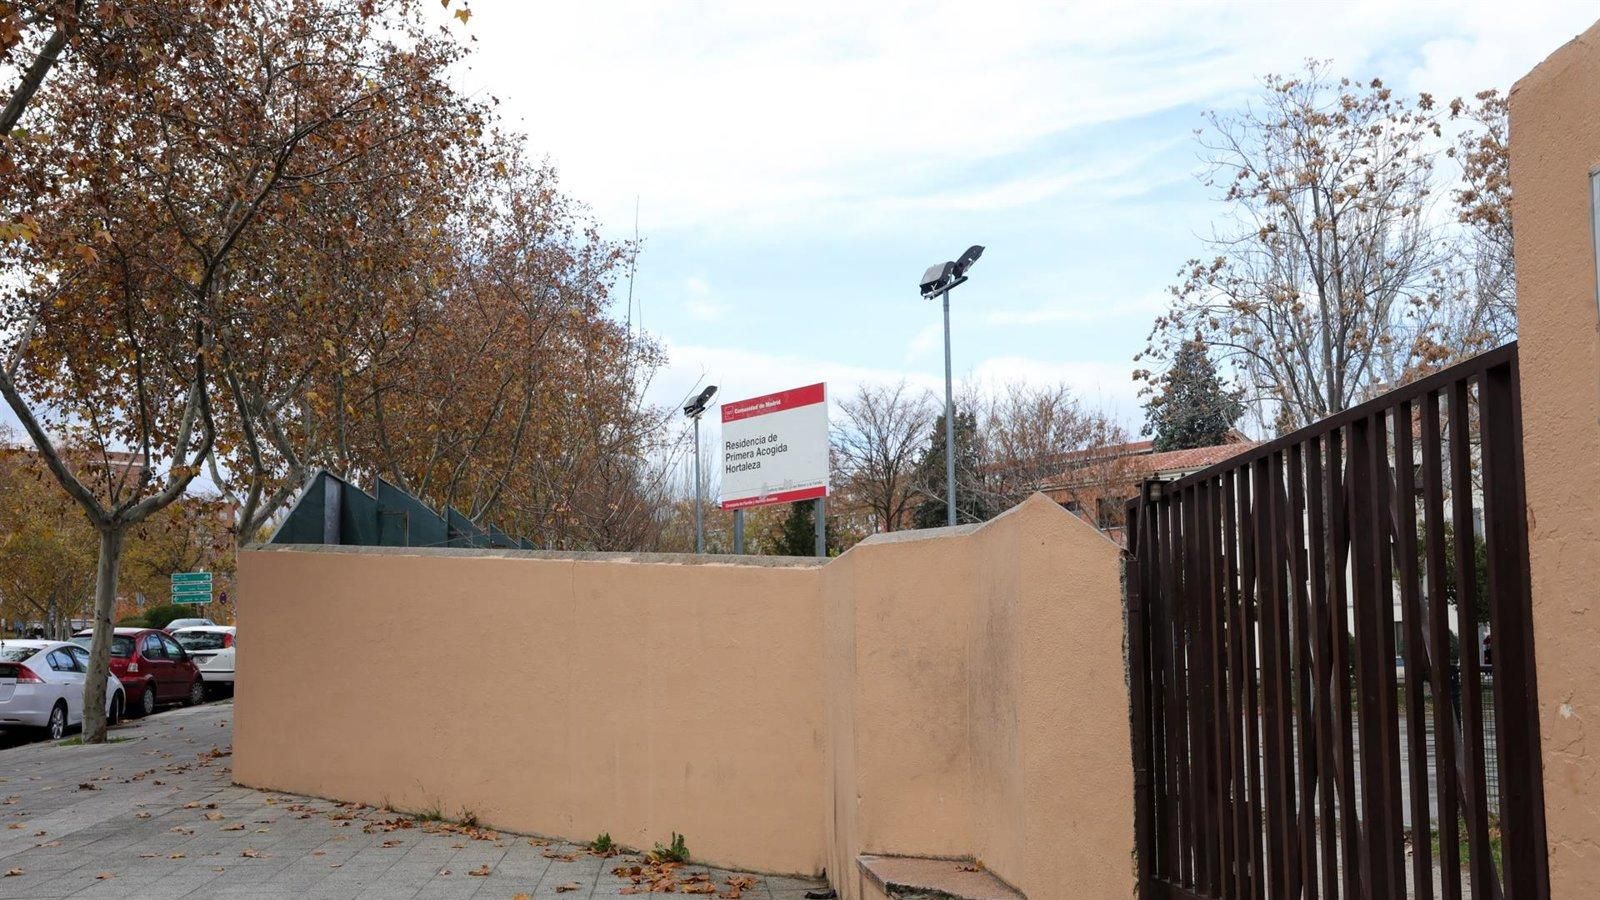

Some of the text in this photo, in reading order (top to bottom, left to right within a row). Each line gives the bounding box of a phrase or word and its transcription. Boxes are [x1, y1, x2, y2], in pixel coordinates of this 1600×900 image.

[734, 399, 781, 414] Comunidad de Madrid
[725, 433, 778, 451] Residencia de
[725, 443, 788, 462] Primera Acogida
[725, 461, 761, 474] Hortaleza
